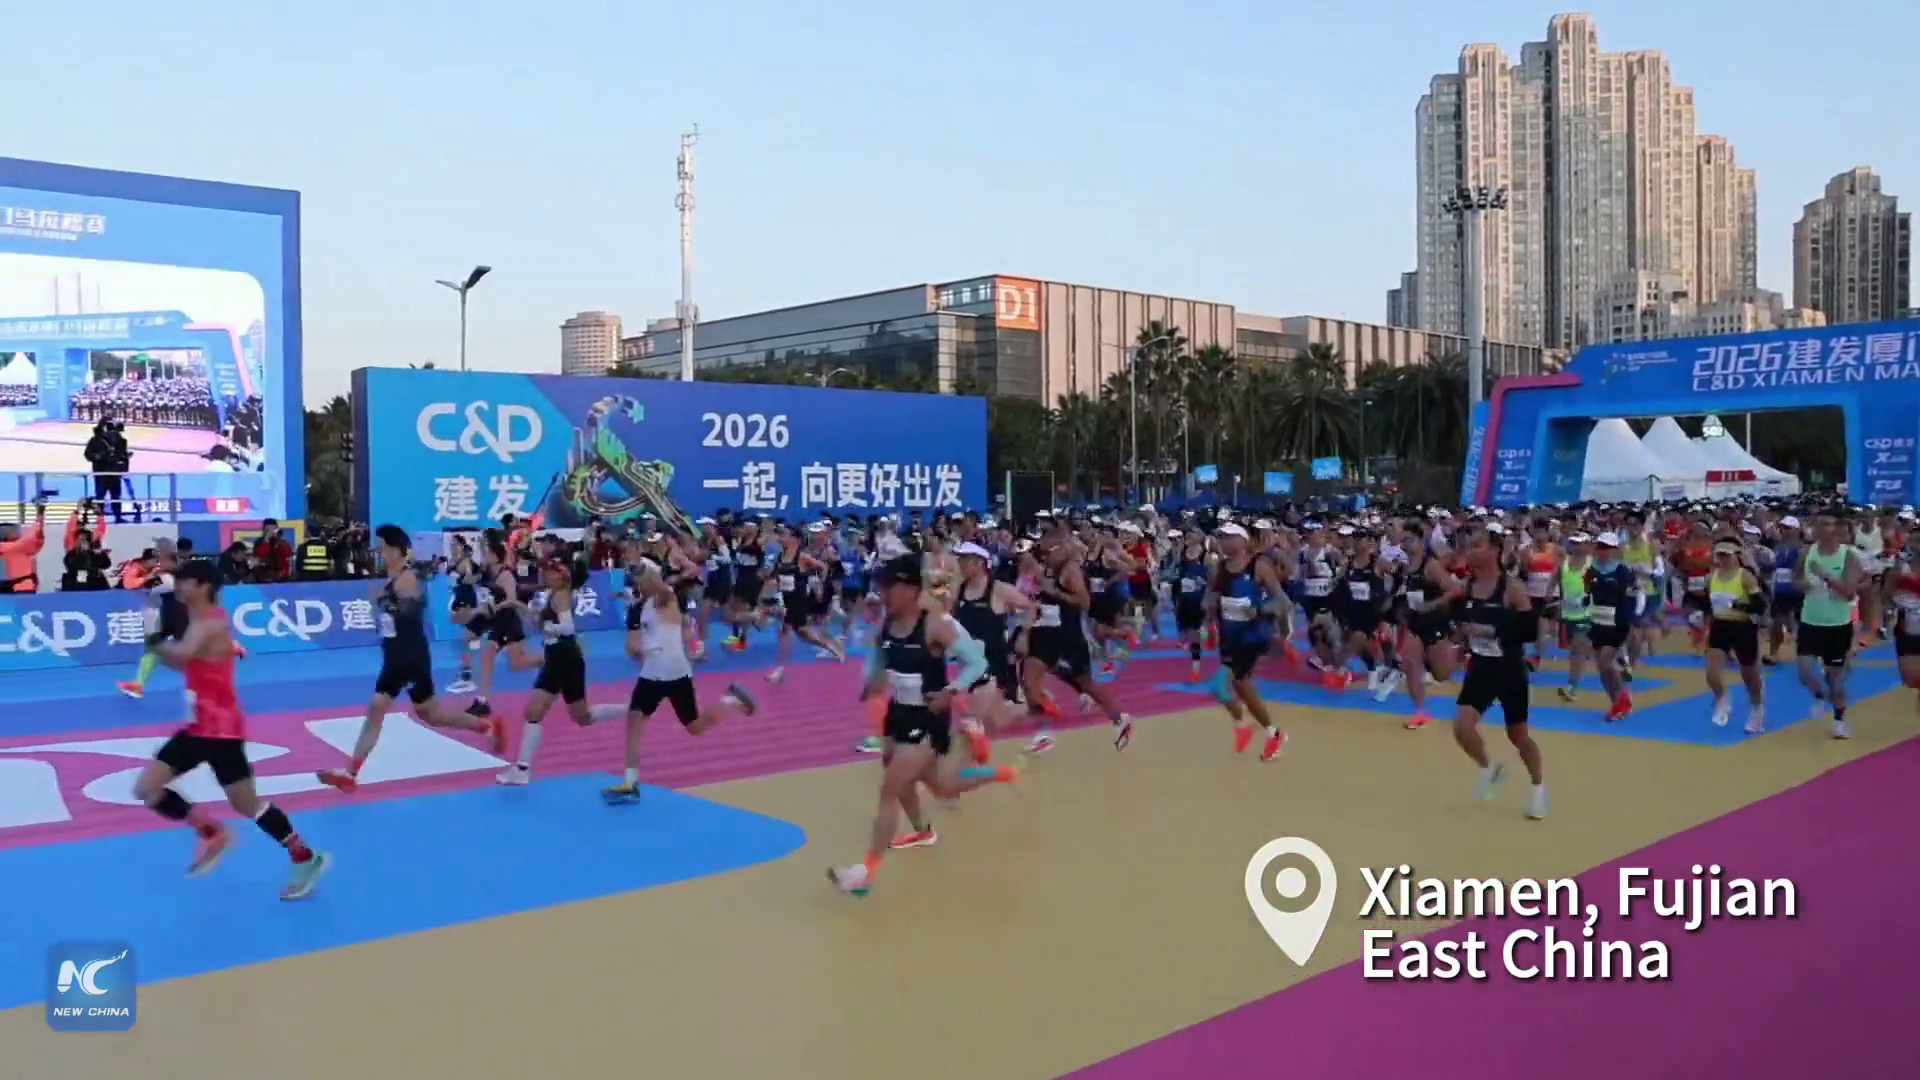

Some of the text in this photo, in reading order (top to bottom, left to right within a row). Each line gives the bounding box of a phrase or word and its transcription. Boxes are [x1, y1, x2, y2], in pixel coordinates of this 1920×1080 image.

[1693, 374, 1745, 392] C&D
[1752, 366, 1864, 388] XIAMEN
[416, 400, 543, 463] C&D
[702, 413, 790, 448] 2026
[433, 474, 533, 522] 建发
[232, 599, 333, 641] C&D
